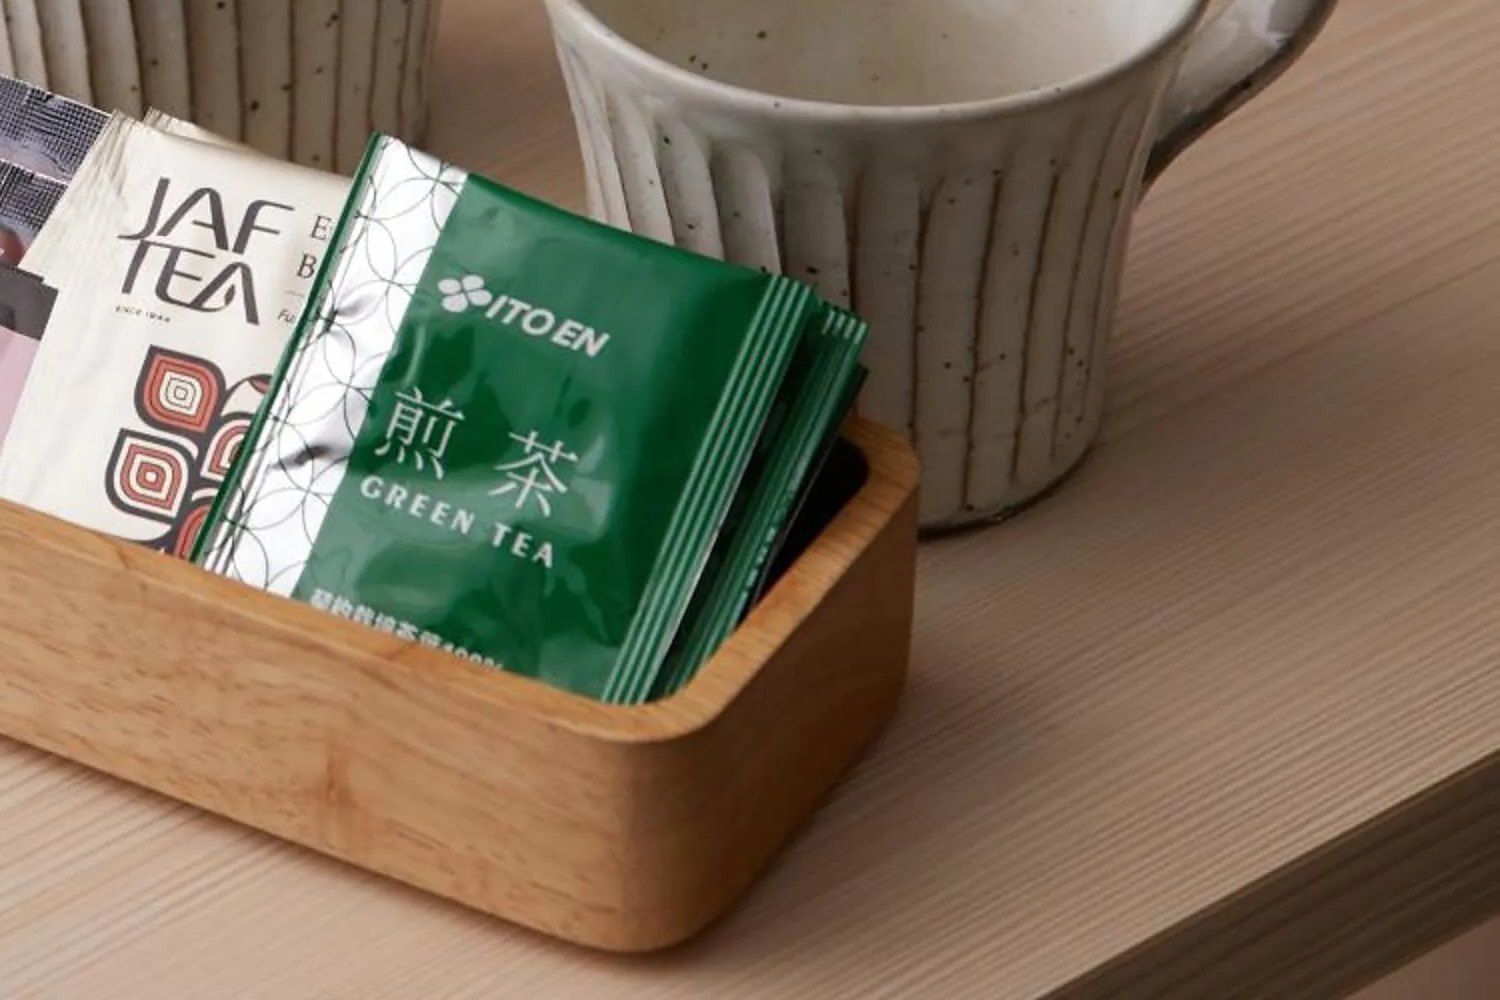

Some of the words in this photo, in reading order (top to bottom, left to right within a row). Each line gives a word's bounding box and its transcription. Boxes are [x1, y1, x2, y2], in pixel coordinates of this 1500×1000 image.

[117, 177, 294, 254] JAF
[310, 215, 331, 240] E
[121, 241, 259, 326] TEA
[485, 295, 551, 337] ITO
[552, 321, 610, 357] EN
[374, 387, 579, 518] 煎茶
[360, 475, 477, 535] GREEN
[491, 518, 556, 569] TEA
